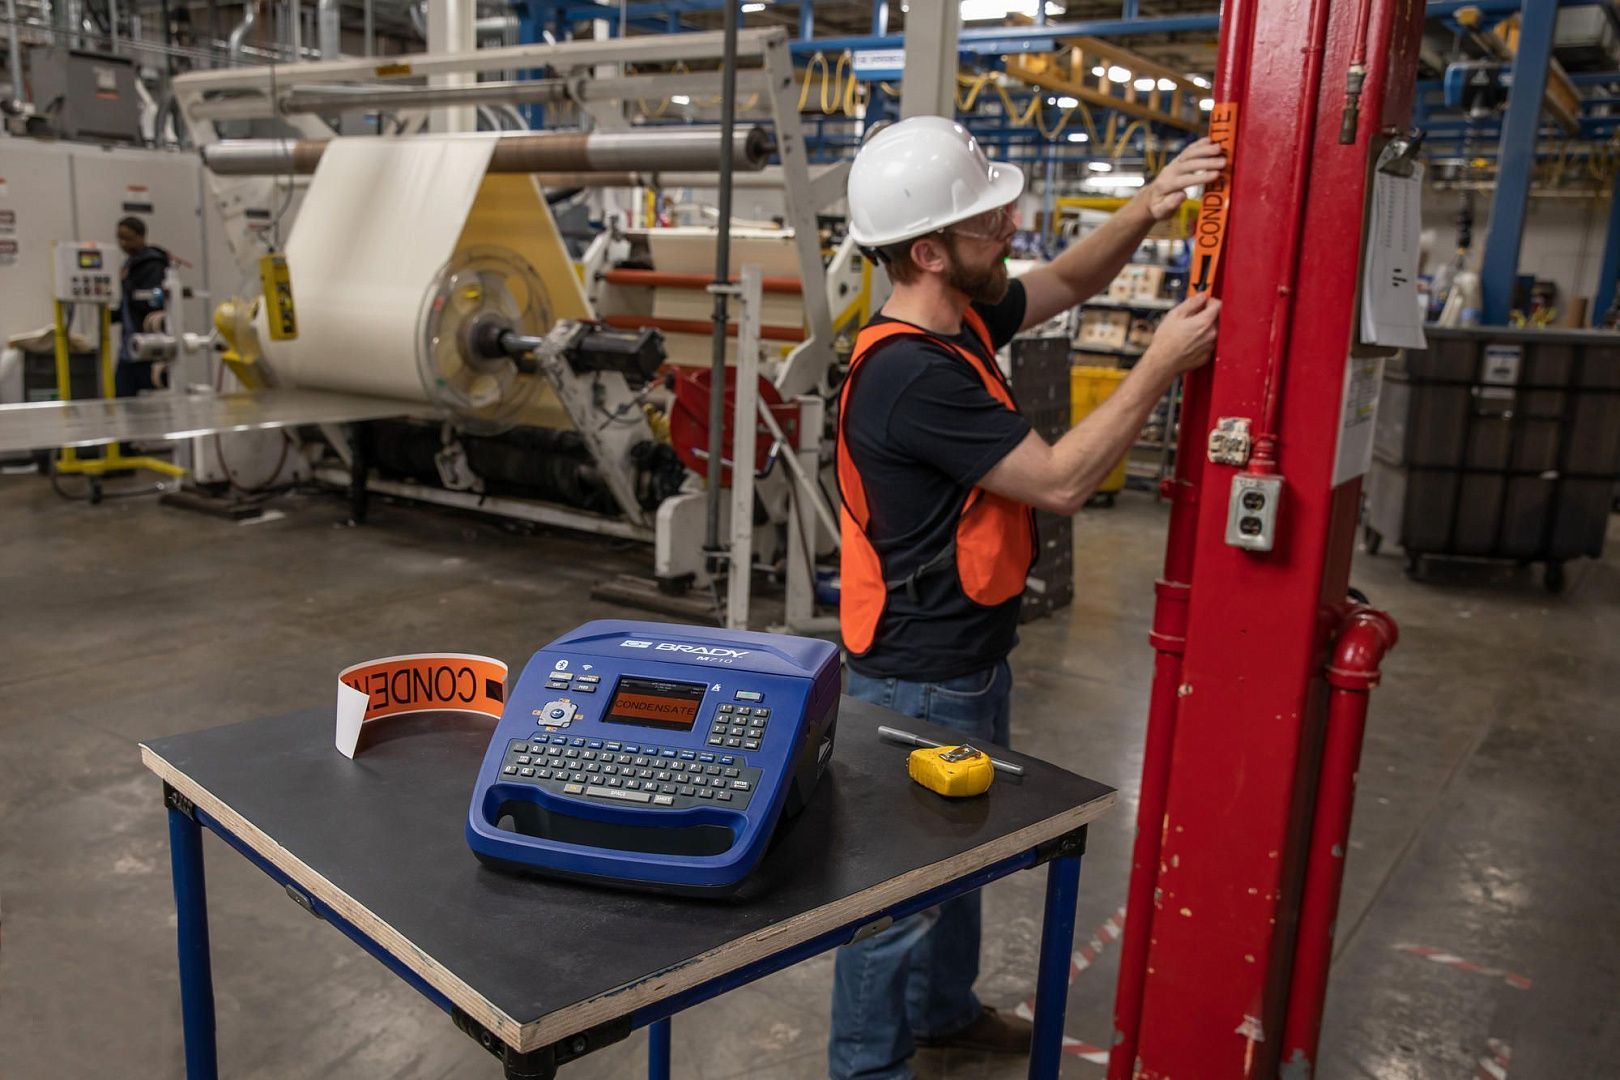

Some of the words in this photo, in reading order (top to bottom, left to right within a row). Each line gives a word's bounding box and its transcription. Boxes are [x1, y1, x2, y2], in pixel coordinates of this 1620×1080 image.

[655, 643, 750, 658] BRADY
[696, 655, 733, 664] M710
[615, 699, 696, 716] CONDENSATE
